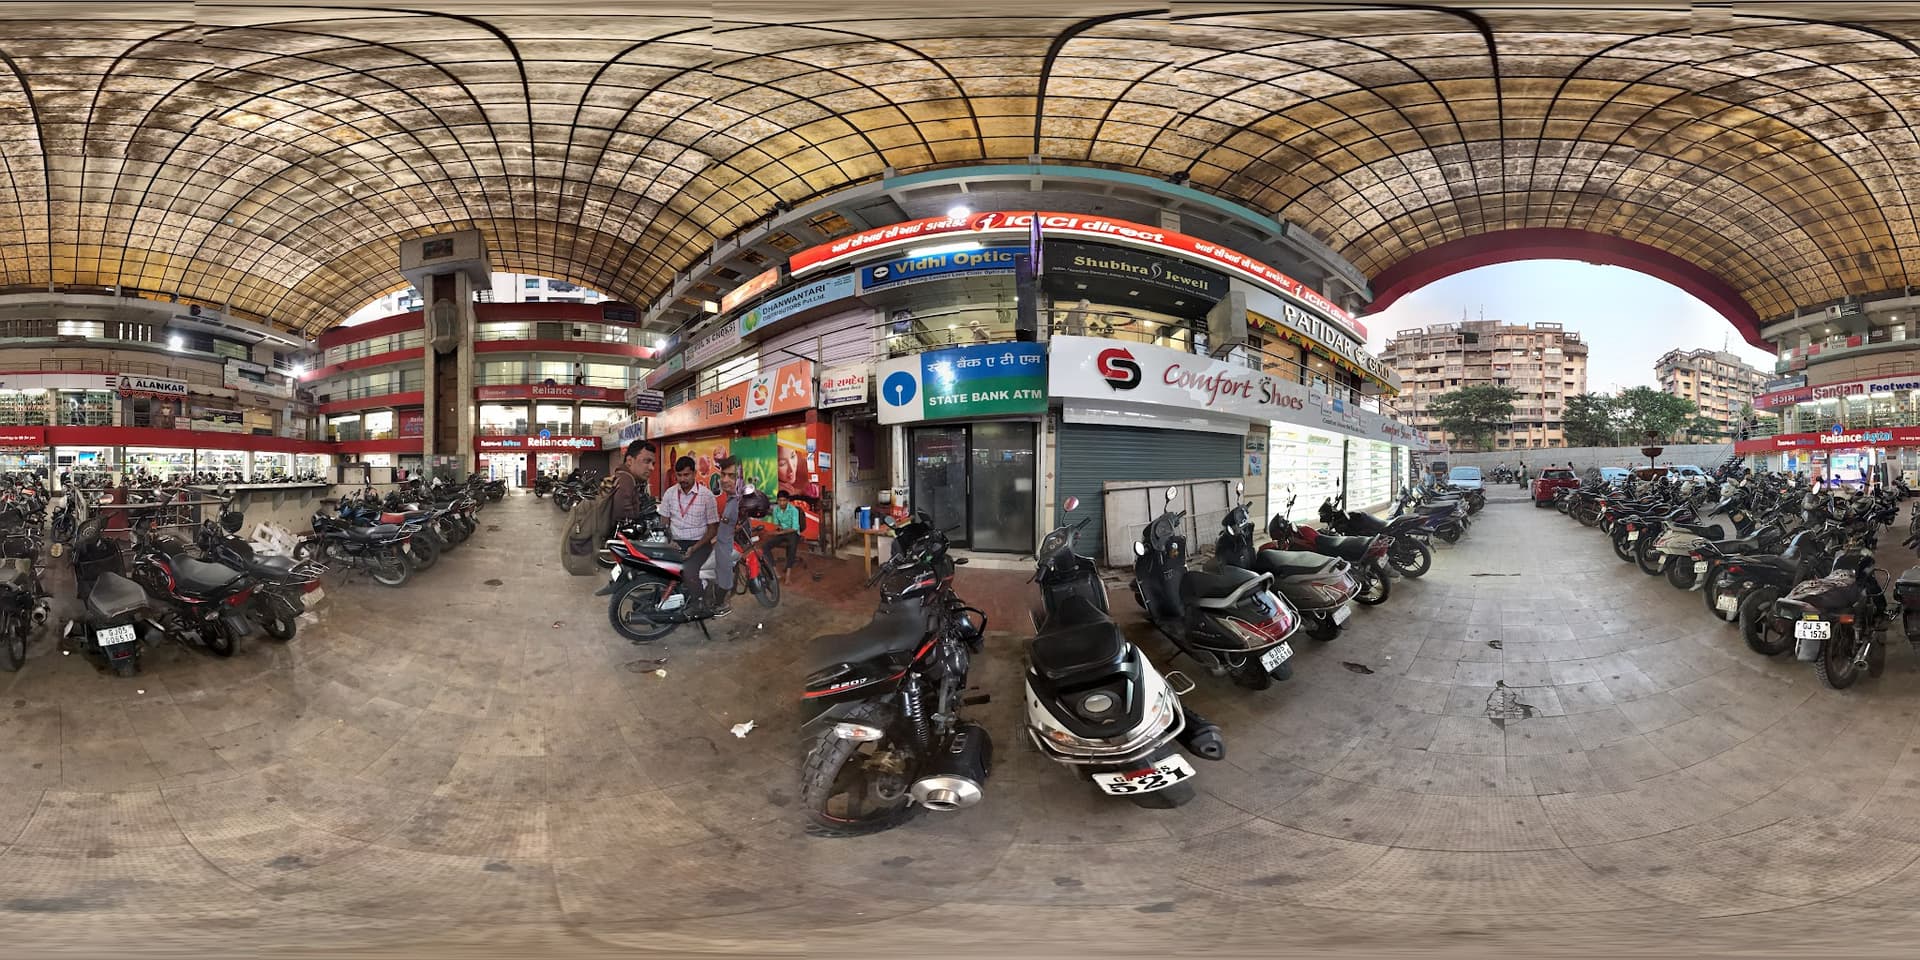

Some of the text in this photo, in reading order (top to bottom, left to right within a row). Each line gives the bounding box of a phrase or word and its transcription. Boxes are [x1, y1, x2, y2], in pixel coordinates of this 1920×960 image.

[1004, 215, 1165, 243] ICICI direct
[953, 251, 1017, 266] Optic
[1074, 256, 1149, 275] Shubhra
[762, 284, 826, 315] DHANWANTARI
[1304, 292, 1330, 312] ICICI
[1284, 303, 1390, 379] PATIDAR GOLD
[957, 355, 982, 369] बैंक
[986, 356, 996, 368] ए
[1000, 352, 1014, 365] टी
[1019, 354, 1041, 365] एम
[135, 380, 185, 393] ALANKAR
[532, 385, 574, 396] Reliance
[1163, 363, 1304, 410] Comfort Shoes
[1813, 383, 1864, 400] Sangam
[929, 389, 1043, 406] STATE BANK ATM
[1771, 393, 1795, 405] સંગમ
[527, 437, 569, 447] Reliance
[1820, 433, 1861, 444] Reliance
[1861, 430, 1893, 443] digital
[1802, 622, 1821, 630] GJ 5
[1106, 766, 1189, 793] 521
